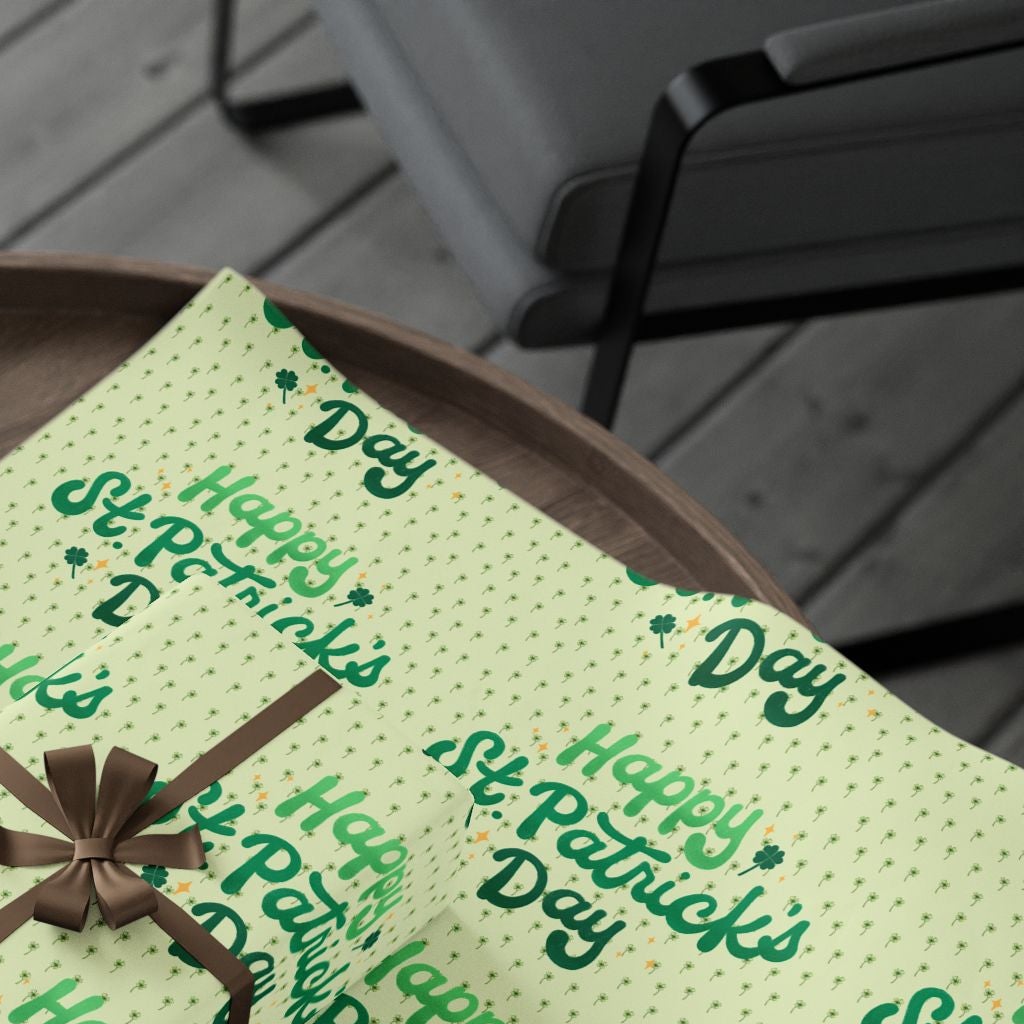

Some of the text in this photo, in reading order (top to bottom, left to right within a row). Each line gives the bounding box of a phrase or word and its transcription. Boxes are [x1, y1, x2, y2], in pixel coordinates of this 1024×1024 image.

[51, 471, 152, 550] St.
[304, 399, 437, 499] Day
[177, 465, 358, 598] Happy
[688, 618, 847, 728] Day
[556, 723, 763, 871] Happy
[476, 847, 626, 971] Day
[516, 782, 810, 963] Patrick's
